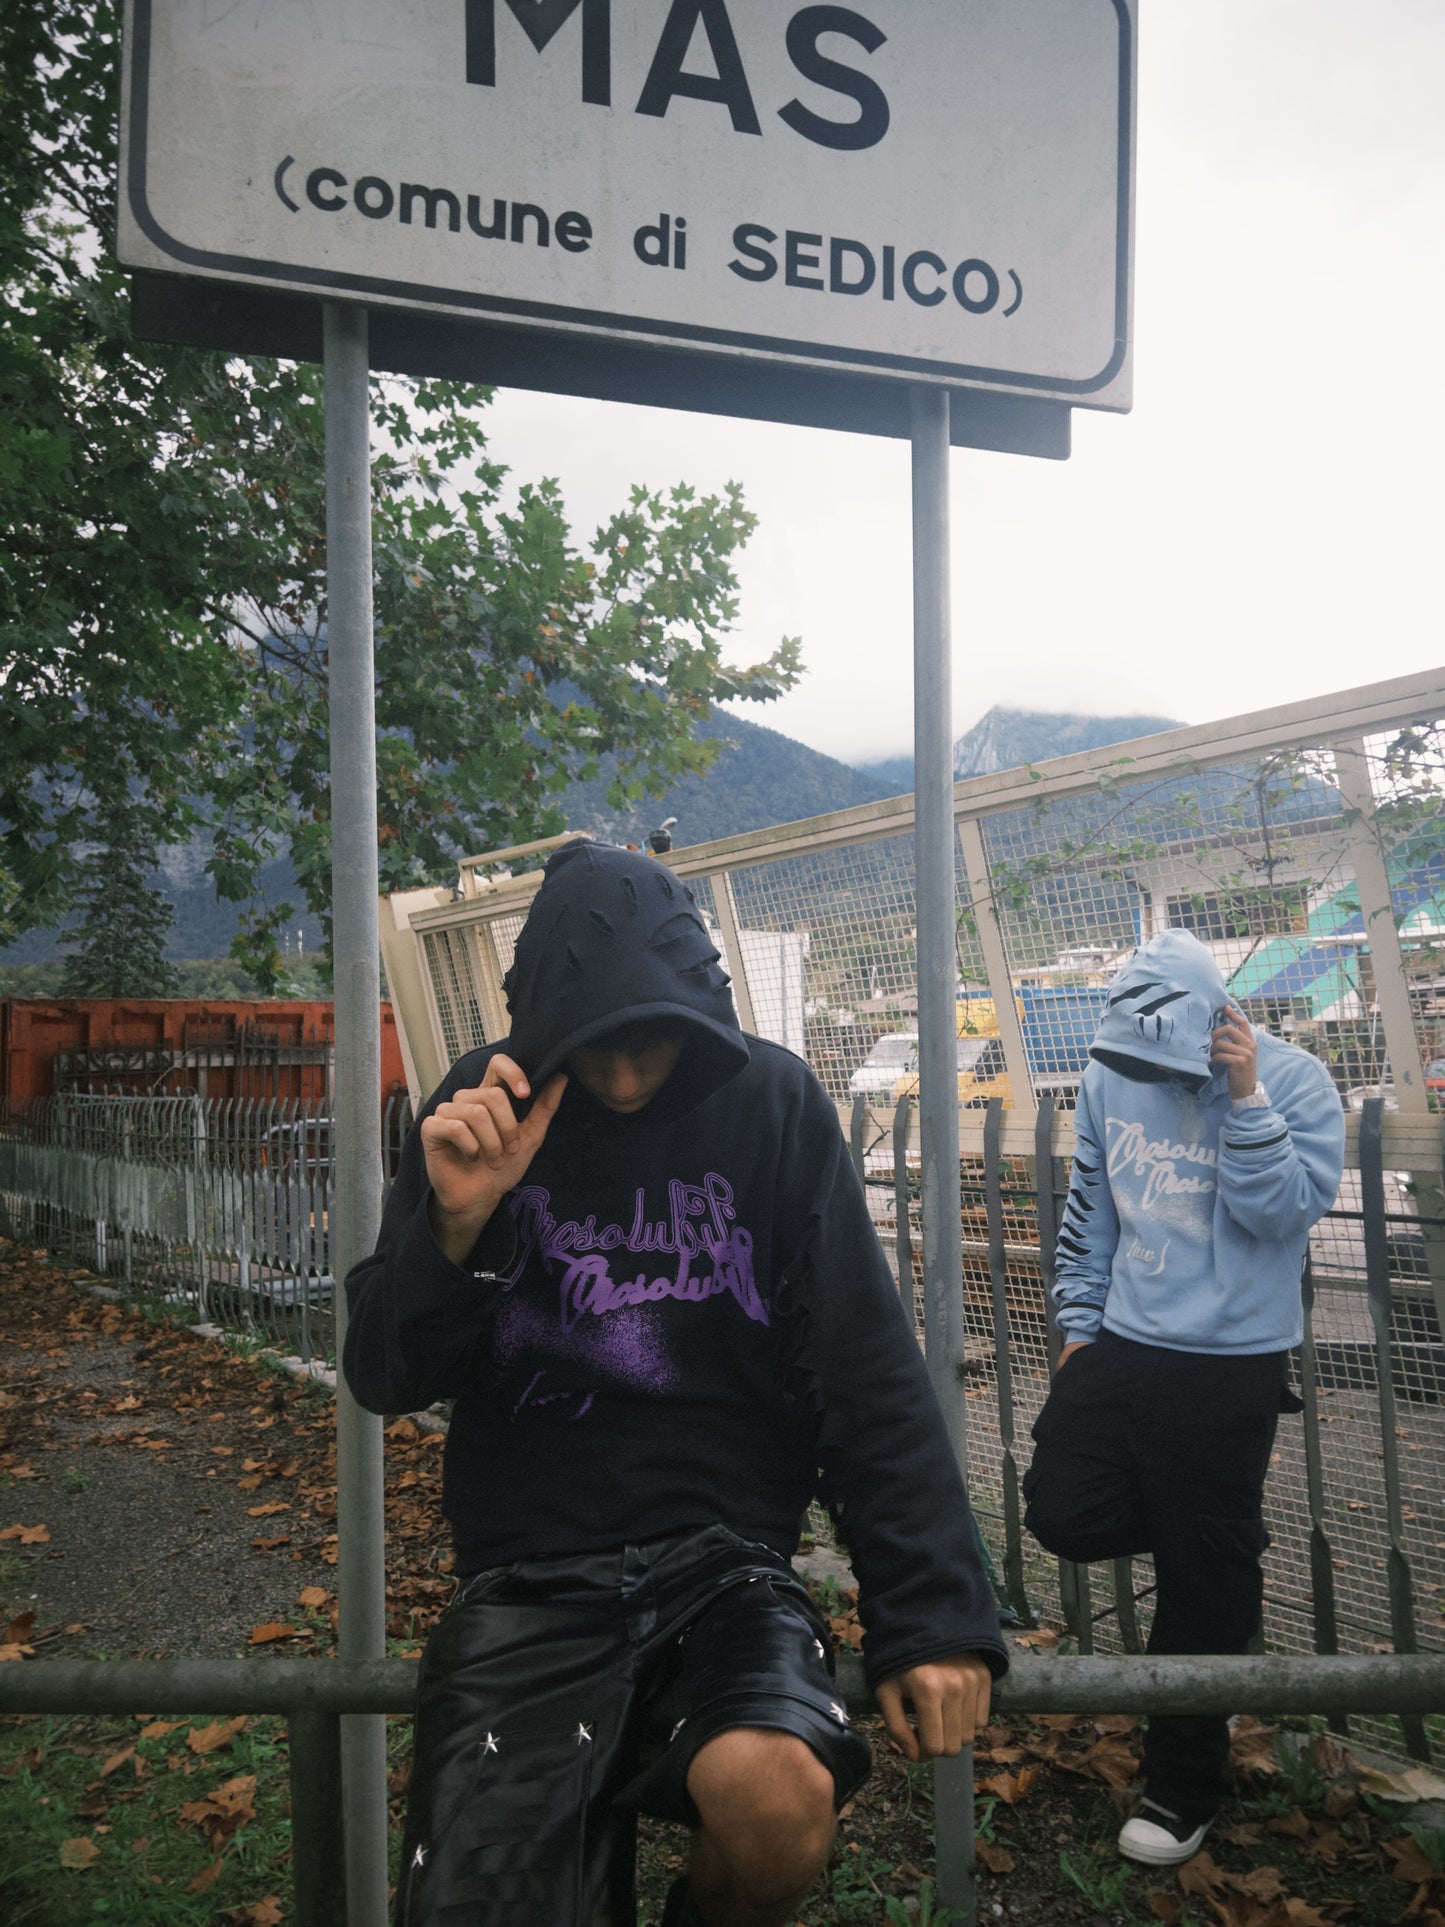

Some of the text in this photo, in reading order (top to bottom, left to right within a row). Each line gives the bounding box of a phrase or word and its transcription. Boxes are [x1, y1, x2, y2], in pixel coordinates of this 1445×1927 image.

[464, 0, 890, 151] MAS
[273, 153, 1023, 319] (comune di SEDICO)
